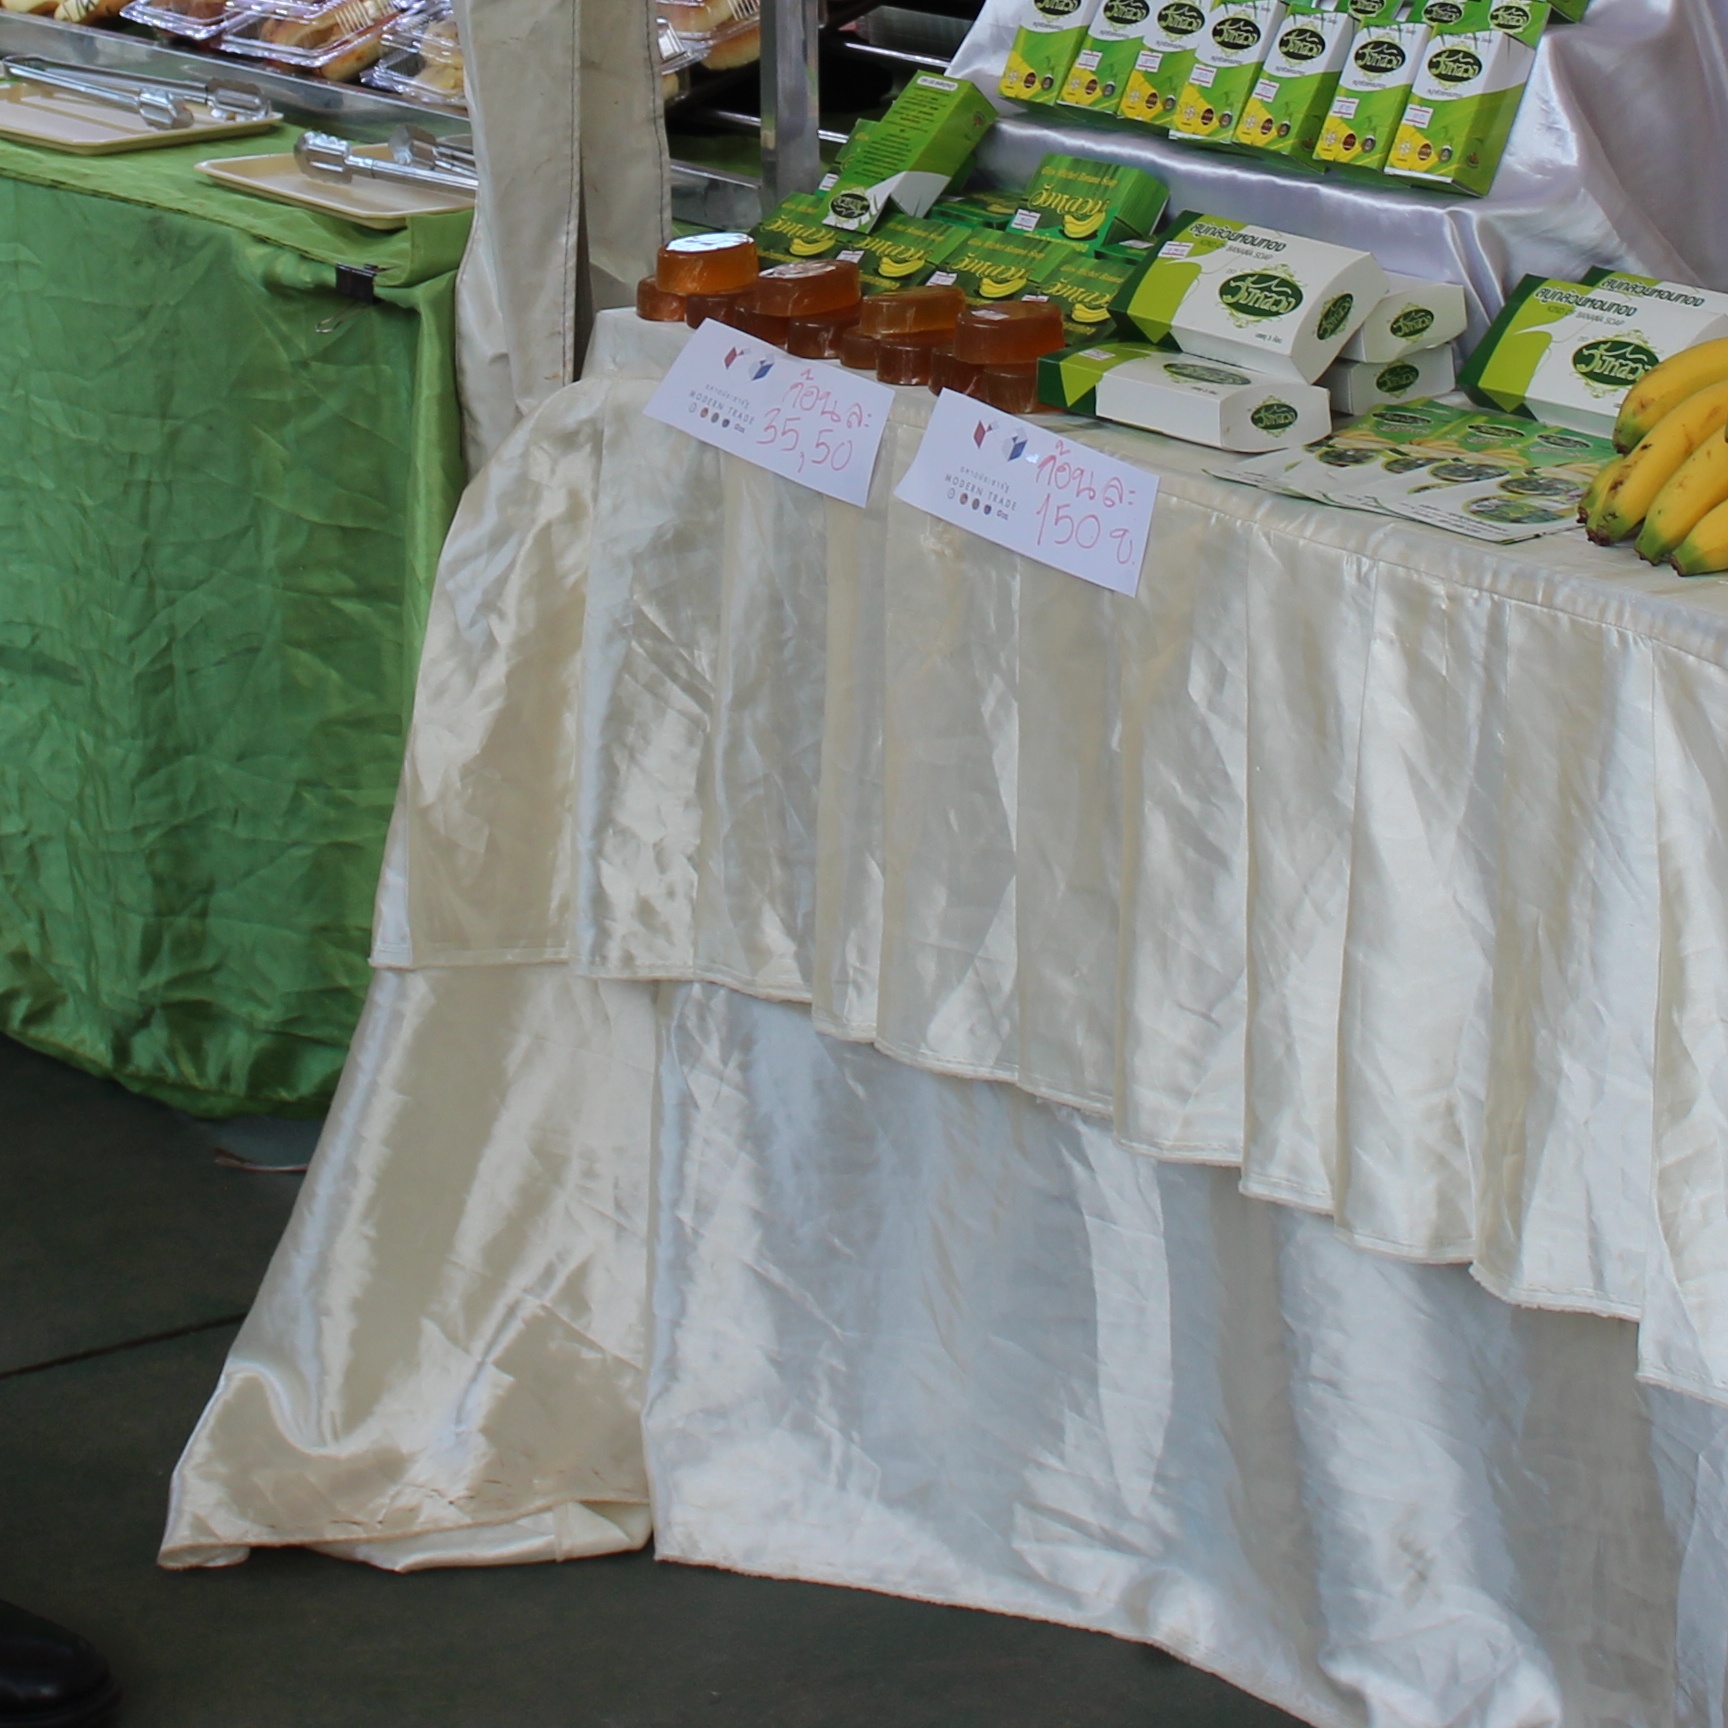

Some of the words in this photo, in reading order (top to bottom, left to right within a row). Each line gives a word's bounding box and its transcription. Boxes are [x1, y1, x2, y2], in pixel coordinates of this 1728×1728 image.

[1222, 274, 1297, 313] วังหลวง
[1535, 287, 1638, 316] สบู่กล้วยหอมทอง
[689, 390, 723, 410] MODERN
[728, 406, 754, 425] TRADE
[944, 474, 983, 497] MODERN
[988, 491, 1017, 511] TRADE
[1036, 493, 1101, 549] 150
